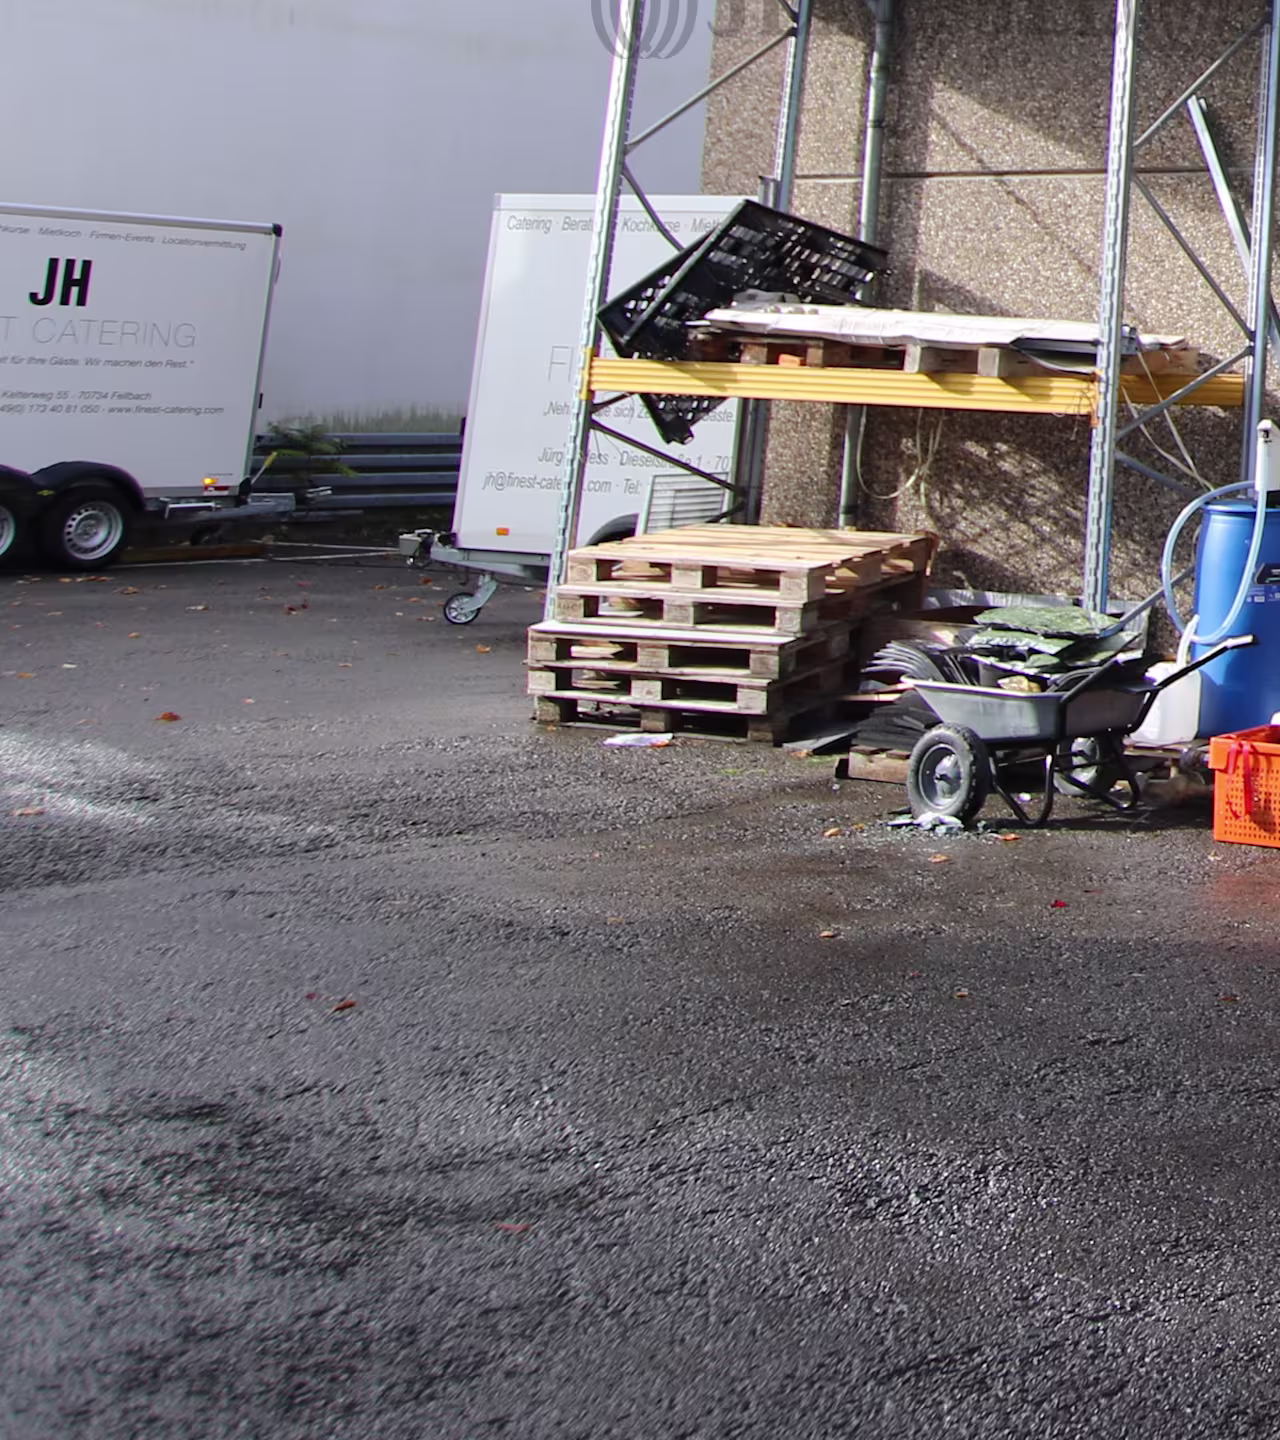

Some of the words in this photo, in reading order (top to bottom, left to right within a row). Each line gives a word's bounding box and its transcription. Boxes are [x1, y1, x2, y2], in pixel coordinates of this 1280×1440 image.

[507, 215, 552, 235] Catering
[89, 230, 155, 243] Firmen-Events
[29, 257, 93, 307] JH
[32, 317, 197, 348] CATERING
[55, 391, 69, 399] 55
[77, 391, 108, 400] 70734
[110, 391, 152, 400] Fellbach
